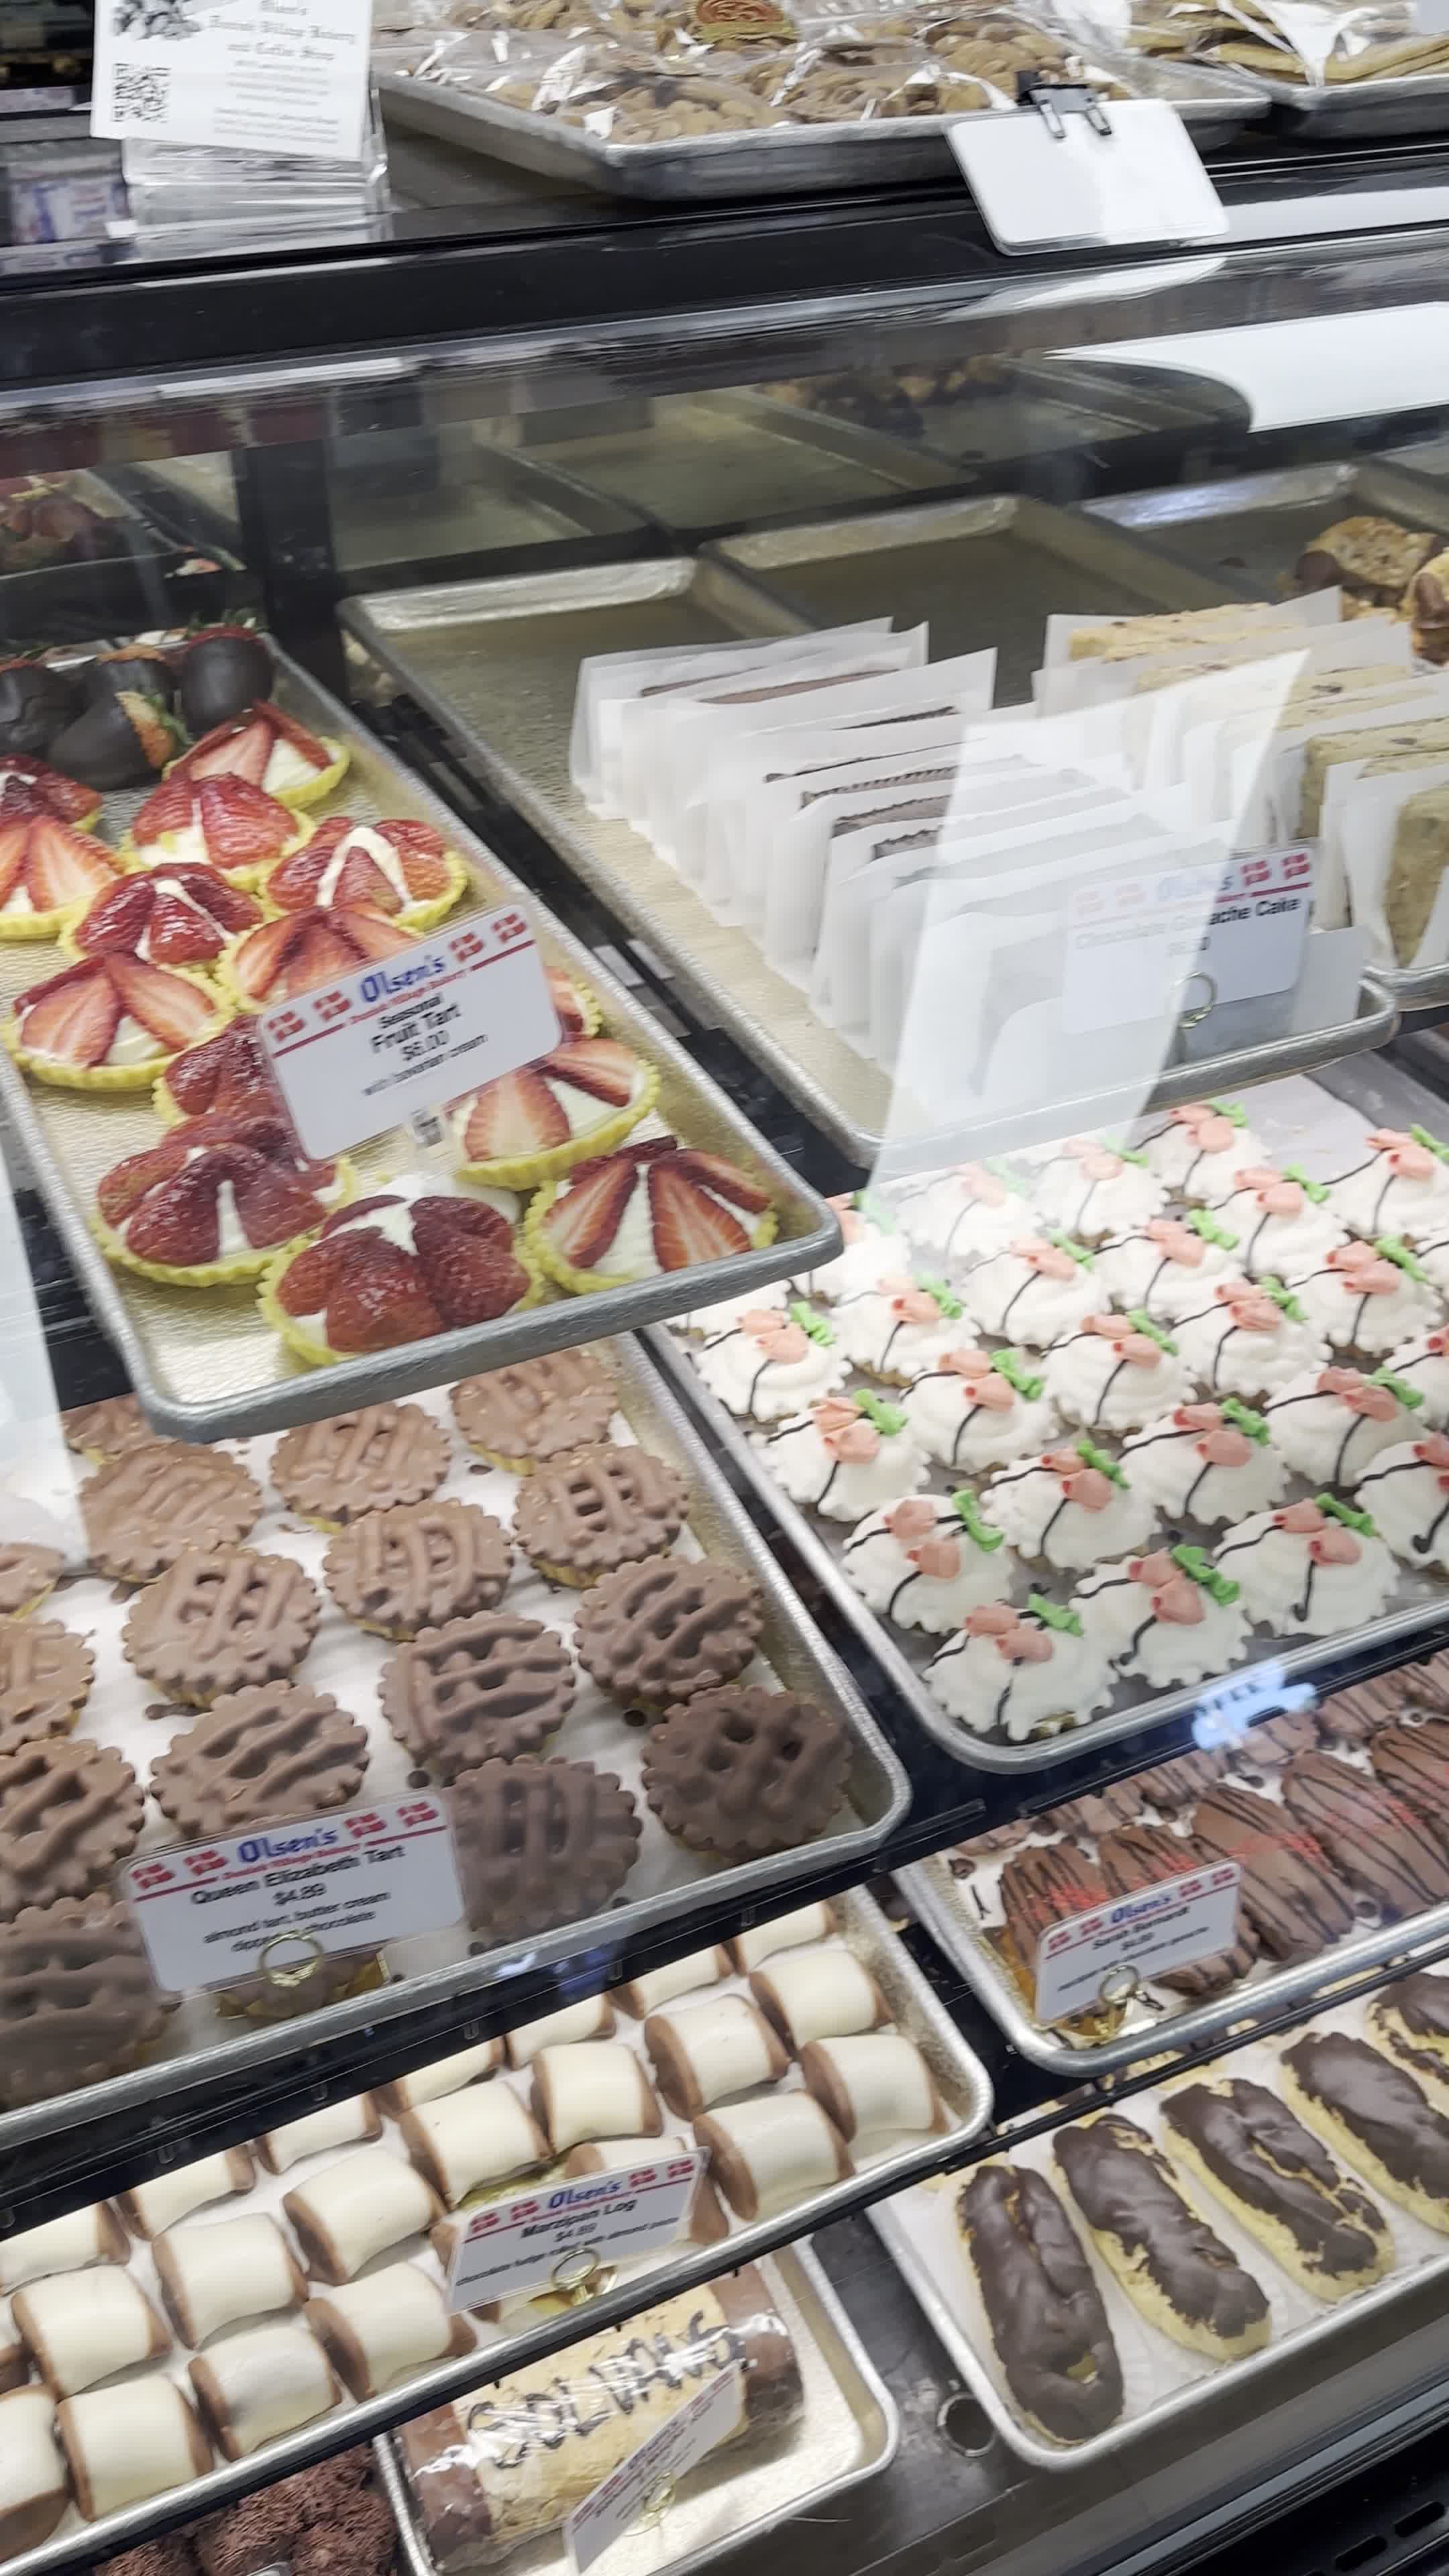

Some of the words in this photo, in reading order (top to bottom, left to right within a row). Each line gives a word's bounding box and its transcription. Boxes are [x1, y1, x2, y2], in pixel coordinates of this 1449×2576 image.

[1254, 898, 1301, 917] Cake
[361, 955, 445, 1002] Olsen's
[370, 1022, 421, 1053] Fruit
[420, 1003, 461, 1030] Tart
[377, 993, 444, 1029] Seasonal
[237, 1827, 339, 1863] Olsen's
[191, 1879, 261, 1905] Queen
[264, 1856, 362, 1886] Elizabeth
[364, 1844, 407, 1863] Tart
[547, 2180, 623, 2210] Olsen's
[521, 2208, 600, 2238] Marzipan
[603, 2199, 639, 2217] Log
